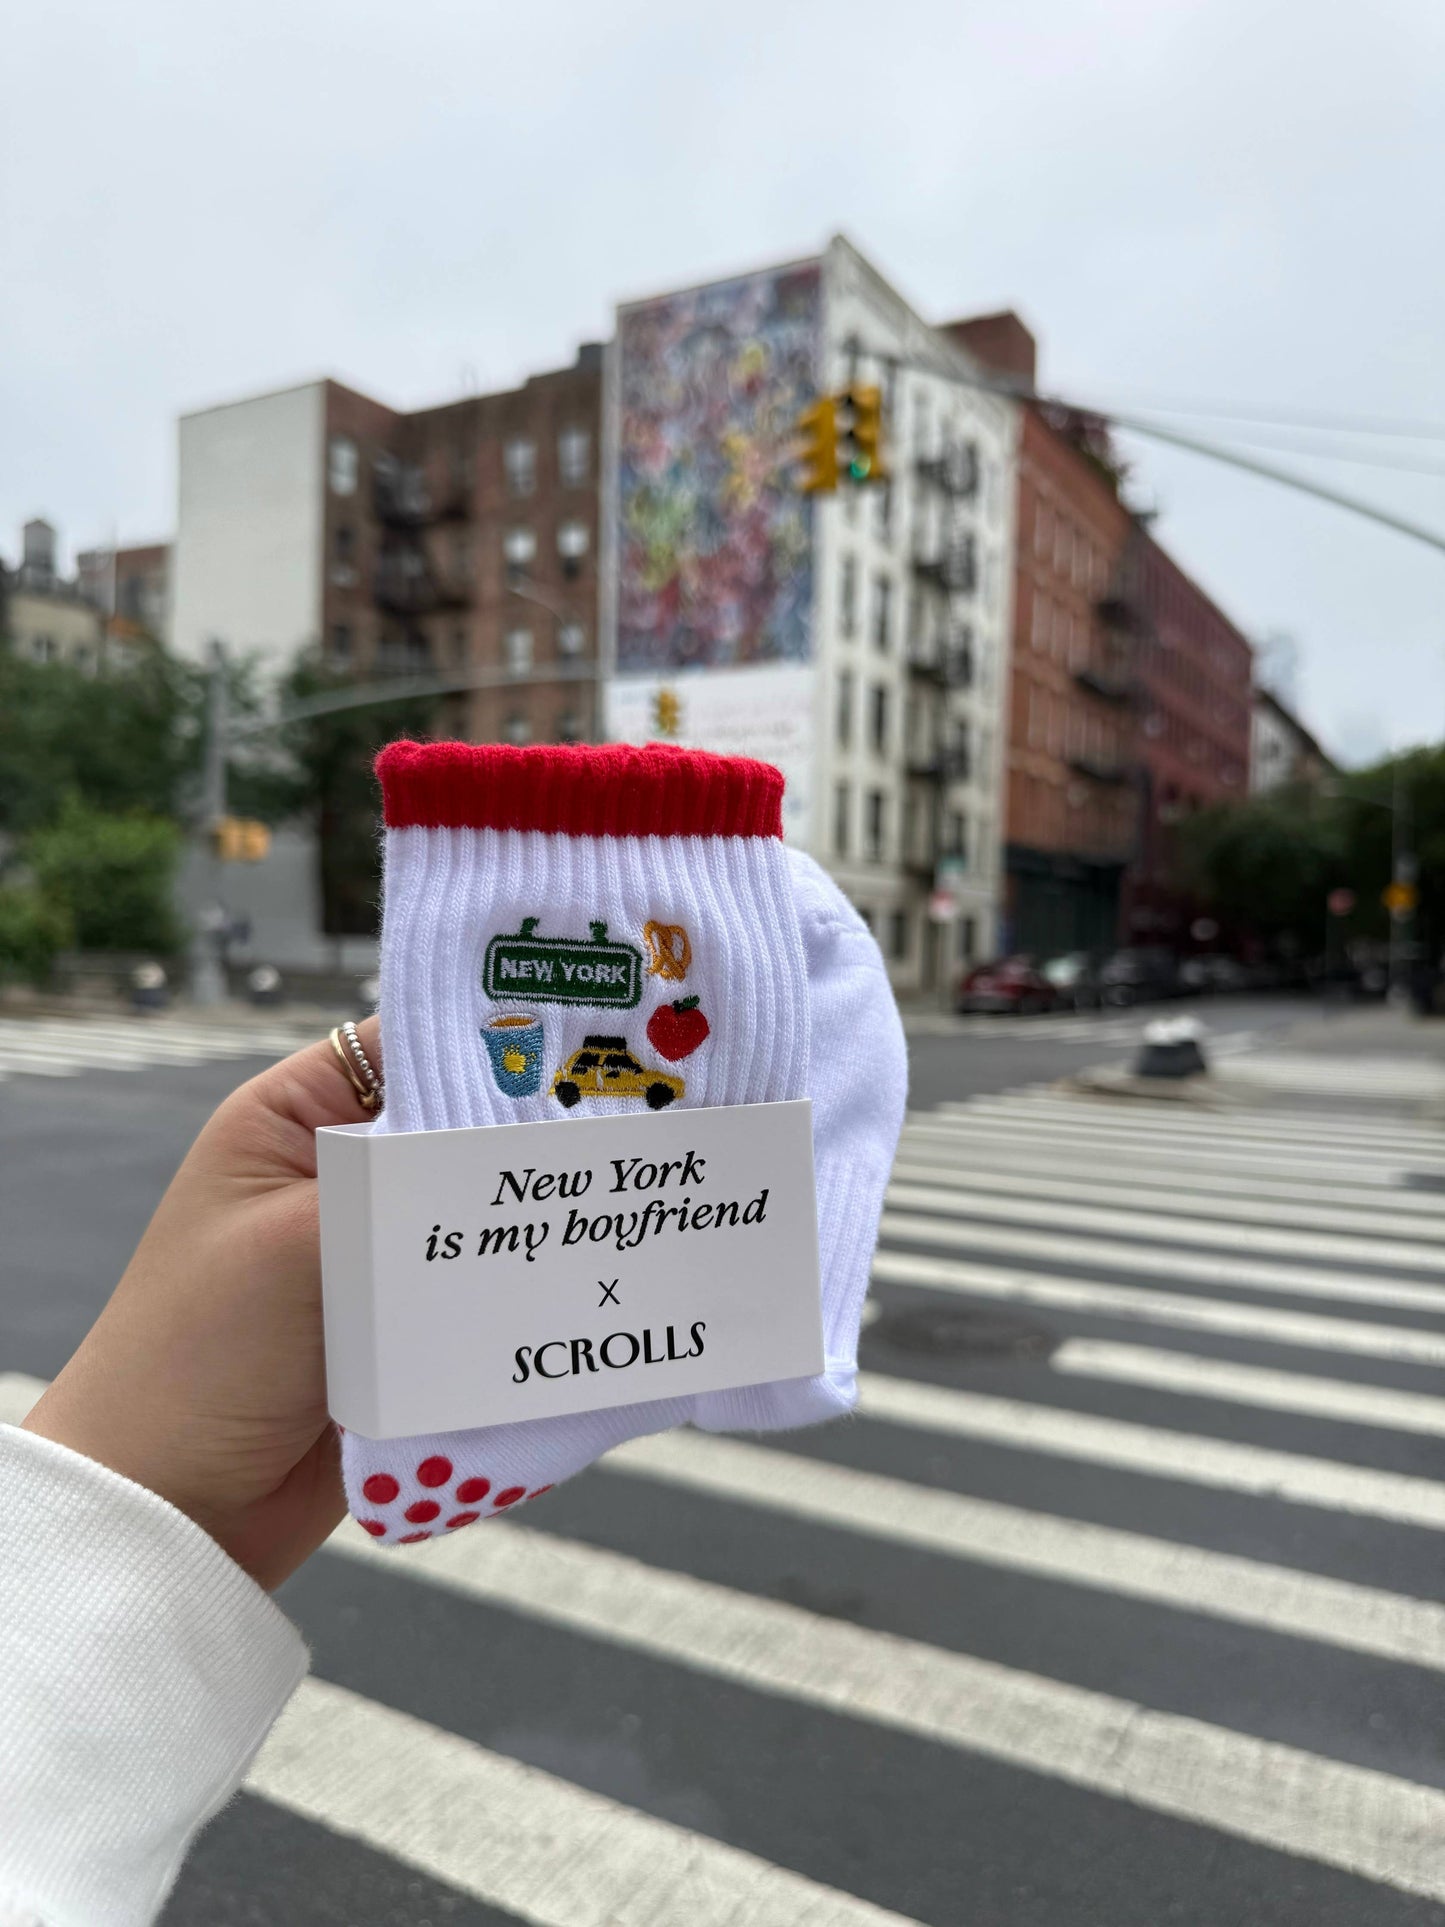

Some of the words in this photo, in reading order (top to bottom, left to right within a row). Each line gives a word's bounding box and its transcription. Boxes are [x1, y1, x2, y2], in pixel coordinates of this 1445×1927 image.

[500, 957, 553, 983] NEW
[559, 961, 627, 984] YORK
[490, 1168, 593, 1206] New
[608, 1150, 707, 1193] York
[425, 1224, 464, 1262] is
[477, 1221, 550, 1263] my
[561, 1188, 770, 1252] boyfriend
[512, 1321, 706, 1384] SCROLLS
